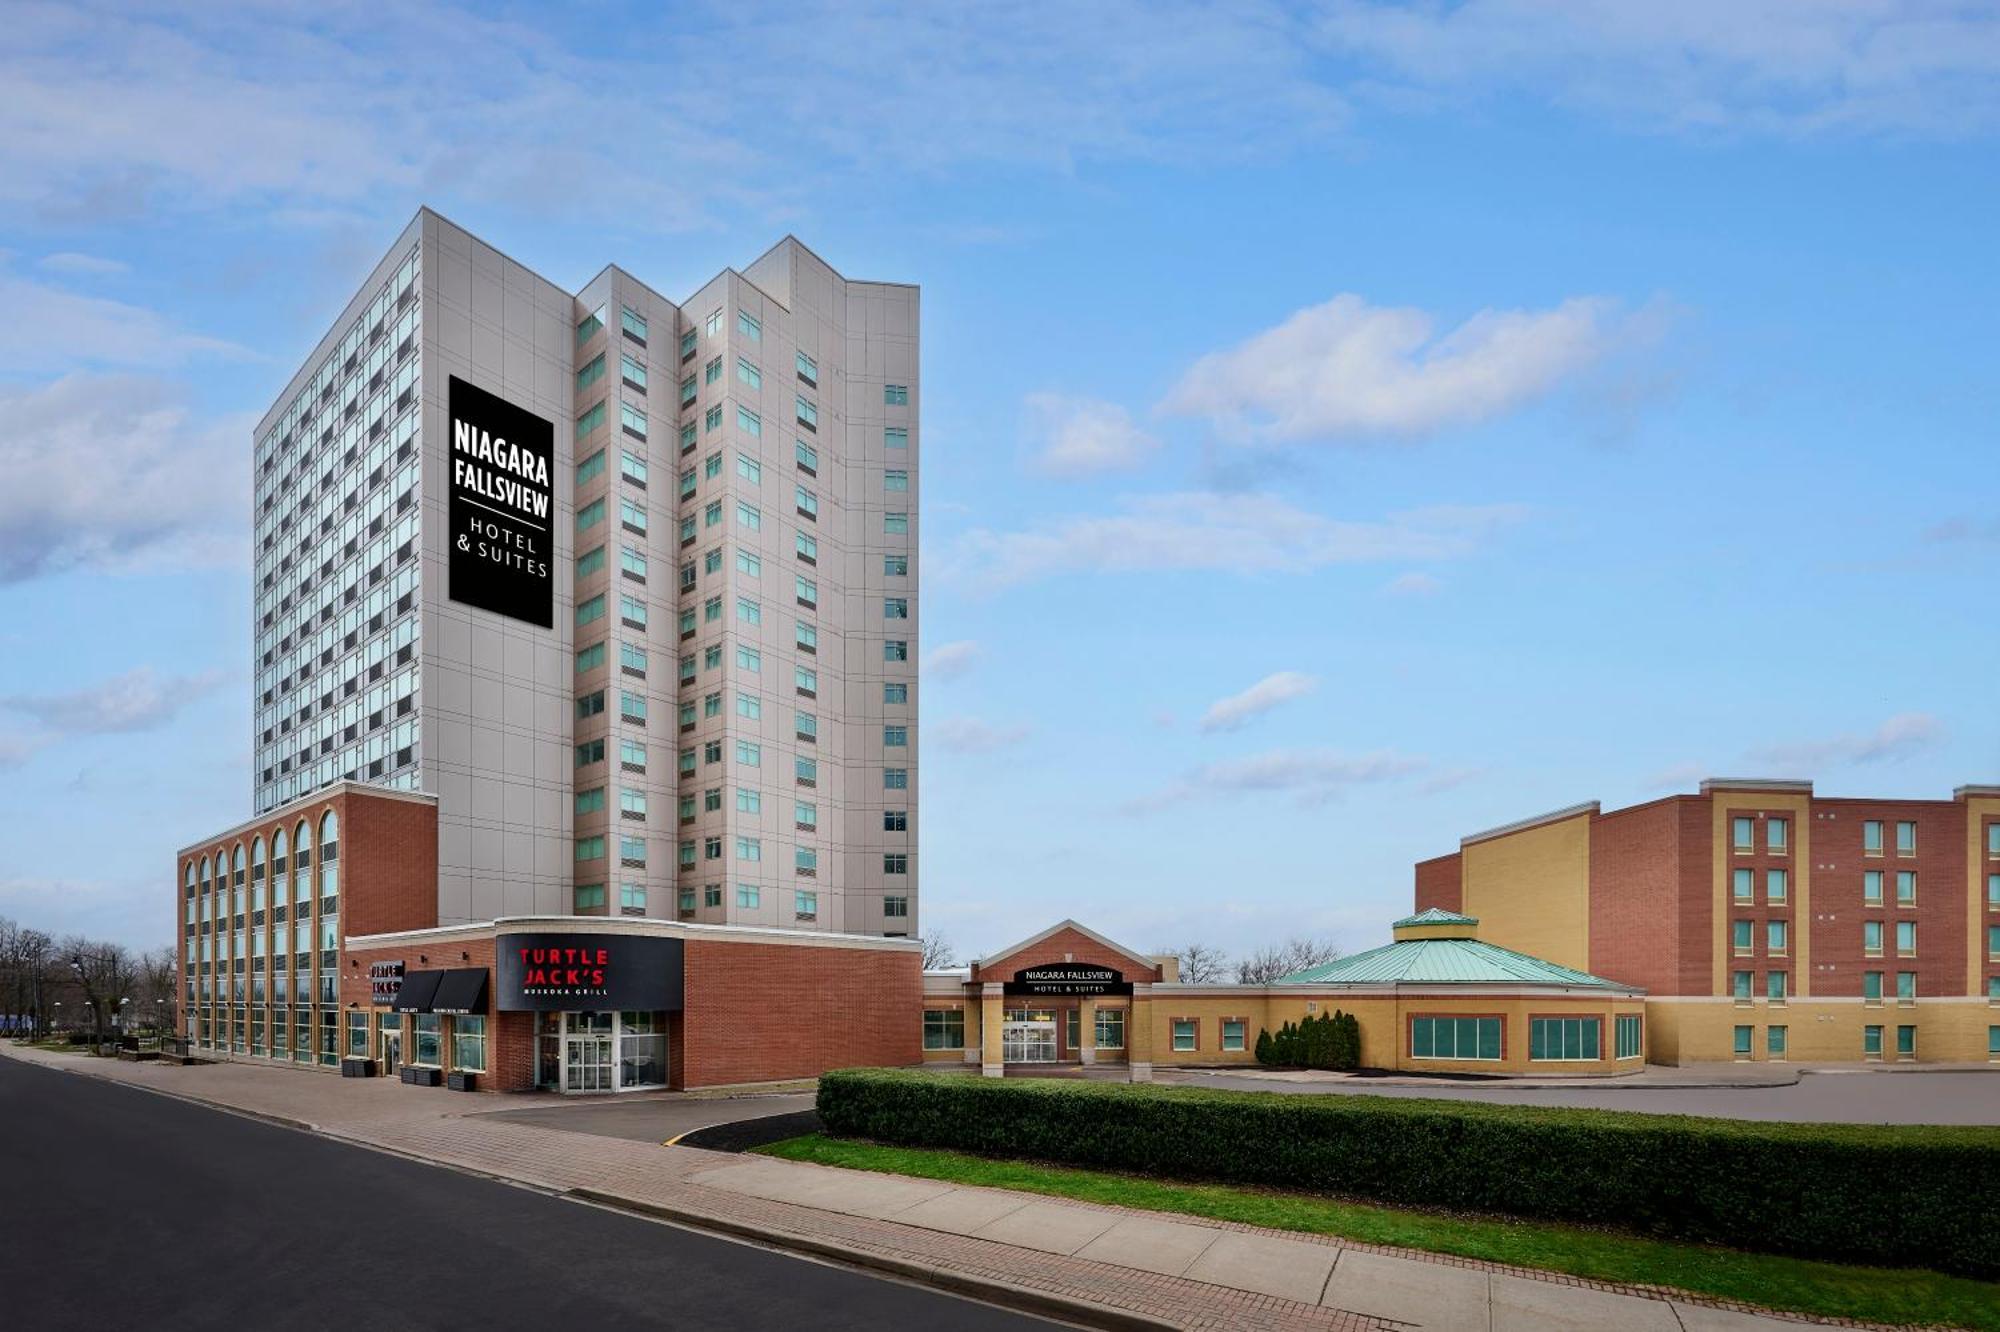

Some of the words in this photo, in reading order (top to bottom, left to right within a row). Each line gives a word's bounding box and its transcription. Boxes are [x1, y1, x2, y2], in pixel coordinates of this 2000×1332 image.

[454, 418, 549, 487] NIAGARA
[455, 458, 549, 518] FALLSVIEW
[471, 517, 536, 554] HOTEL
[457, 533, 470, 552] &
[478, 542, 547, 578] SUITES
[519, 948, 608, 965] TURTLE
[524, 969, 605, 985] JACK'S
[1026, 971, 1065, 980] NIAGARA
[1067, 971, 1113, 980] FALLSVIEW
[1034, 985, 1062, 993] HOTEL
[1075, 985, 1105, 993] SUITES
